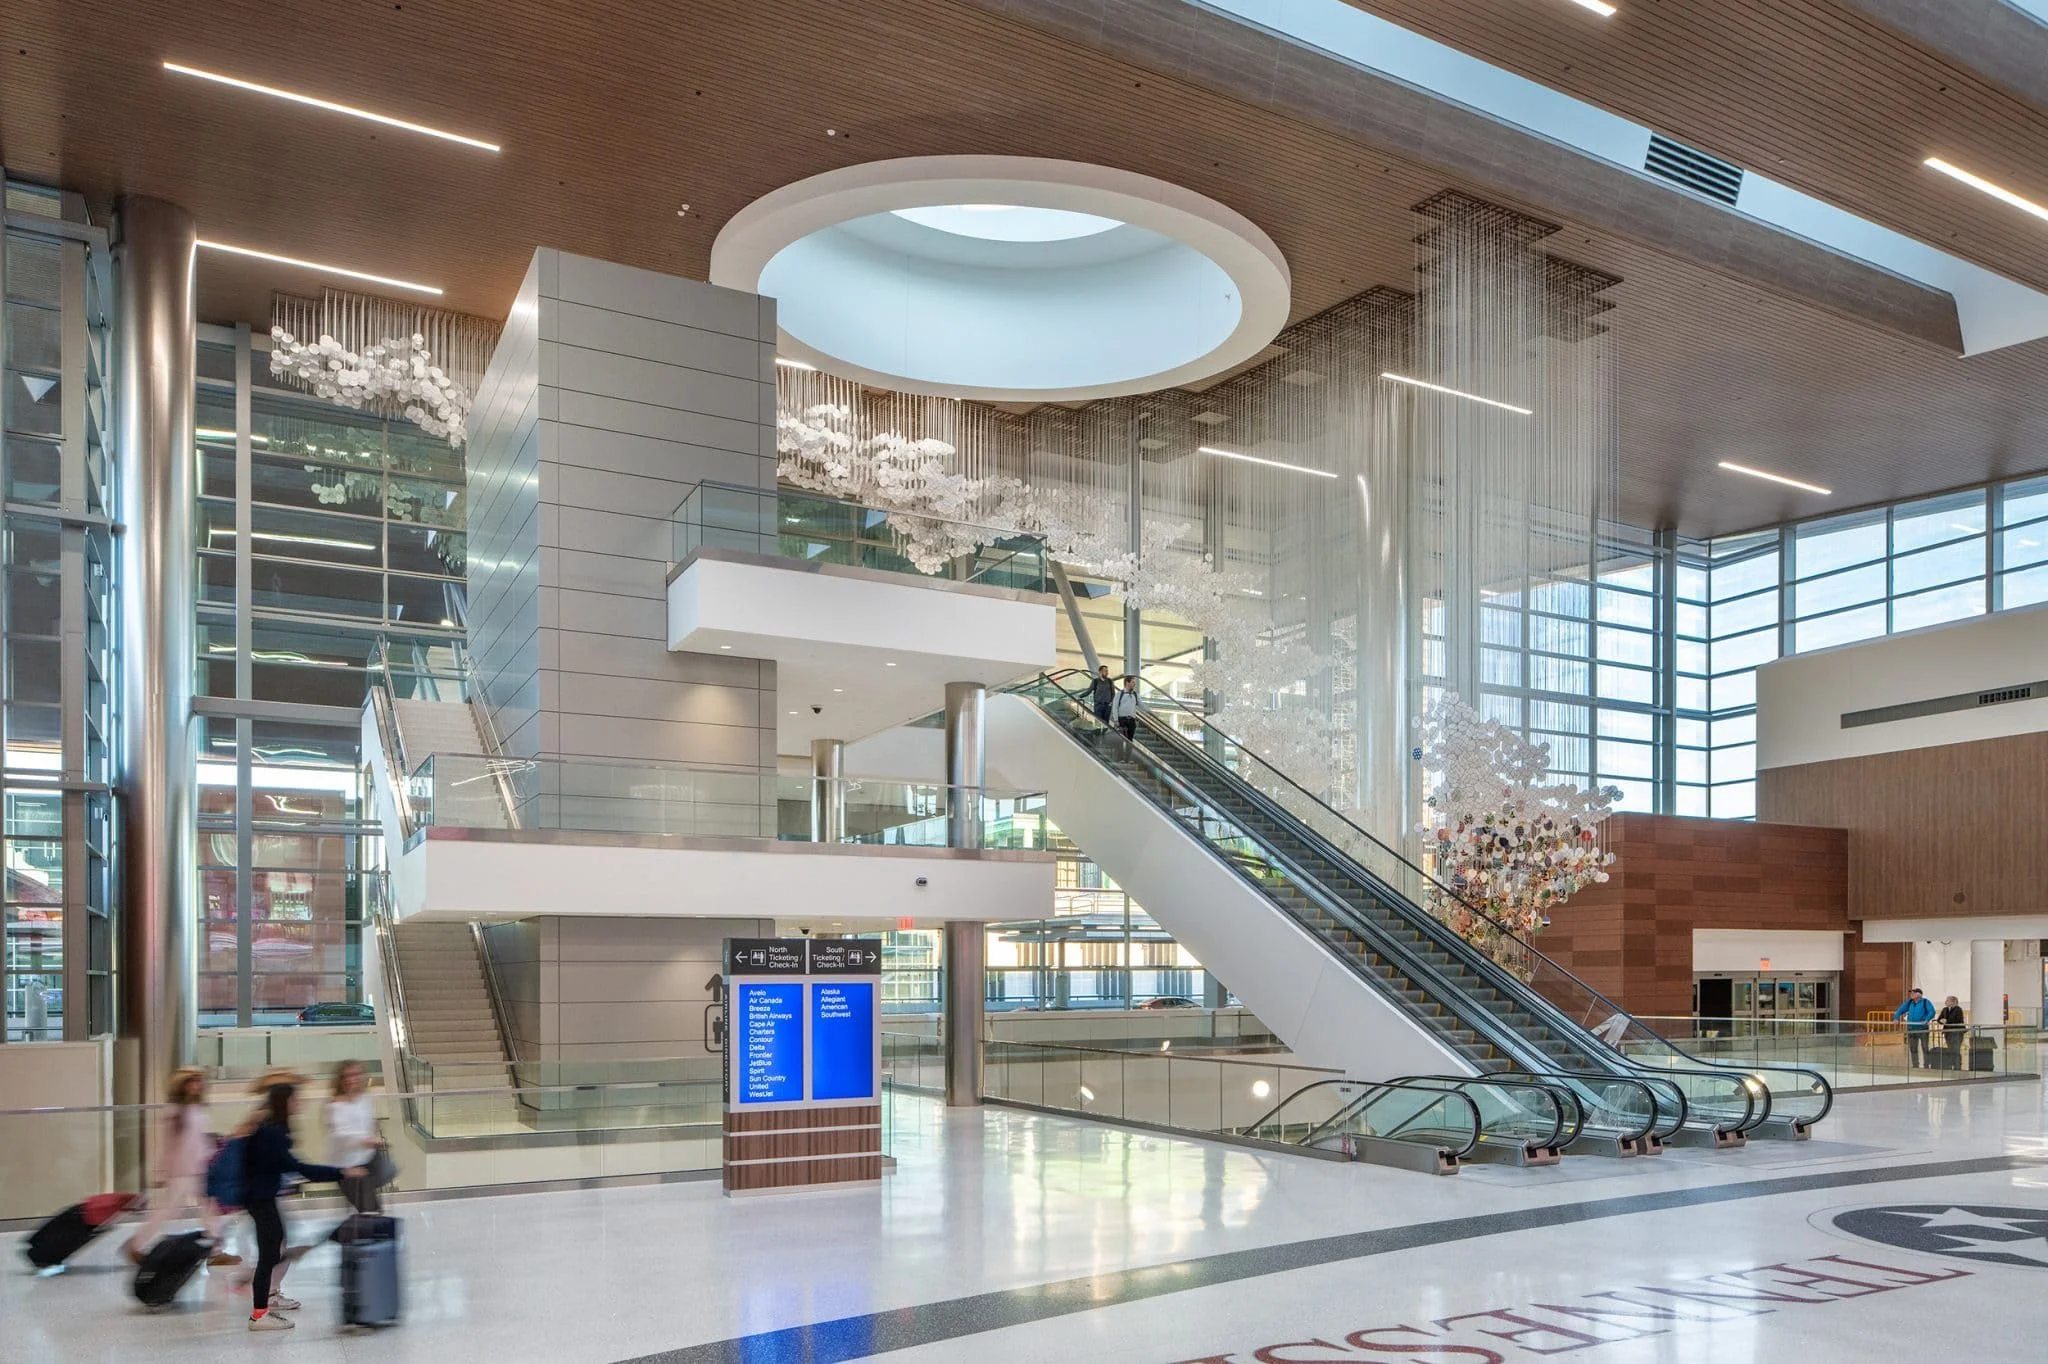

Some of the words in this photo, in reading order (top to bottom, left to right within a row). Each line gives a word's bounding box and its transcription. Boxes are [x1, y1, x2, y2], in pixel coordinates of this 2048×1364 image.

[769, 946, 788, 954] North
[826, 946, 845, 954] South
[769, 954, 799, 962] Ticketing
[812, 954, 841, 962] Ticketing
[769, 961, 799, 969] Check-In
[817, 961, 845, 969] Check-In
[820, 996, 846, 1004] Allegiant
[749, 1059, 772, 1067] JetBlue
[749, 1067, 765, 1075] Spirit
